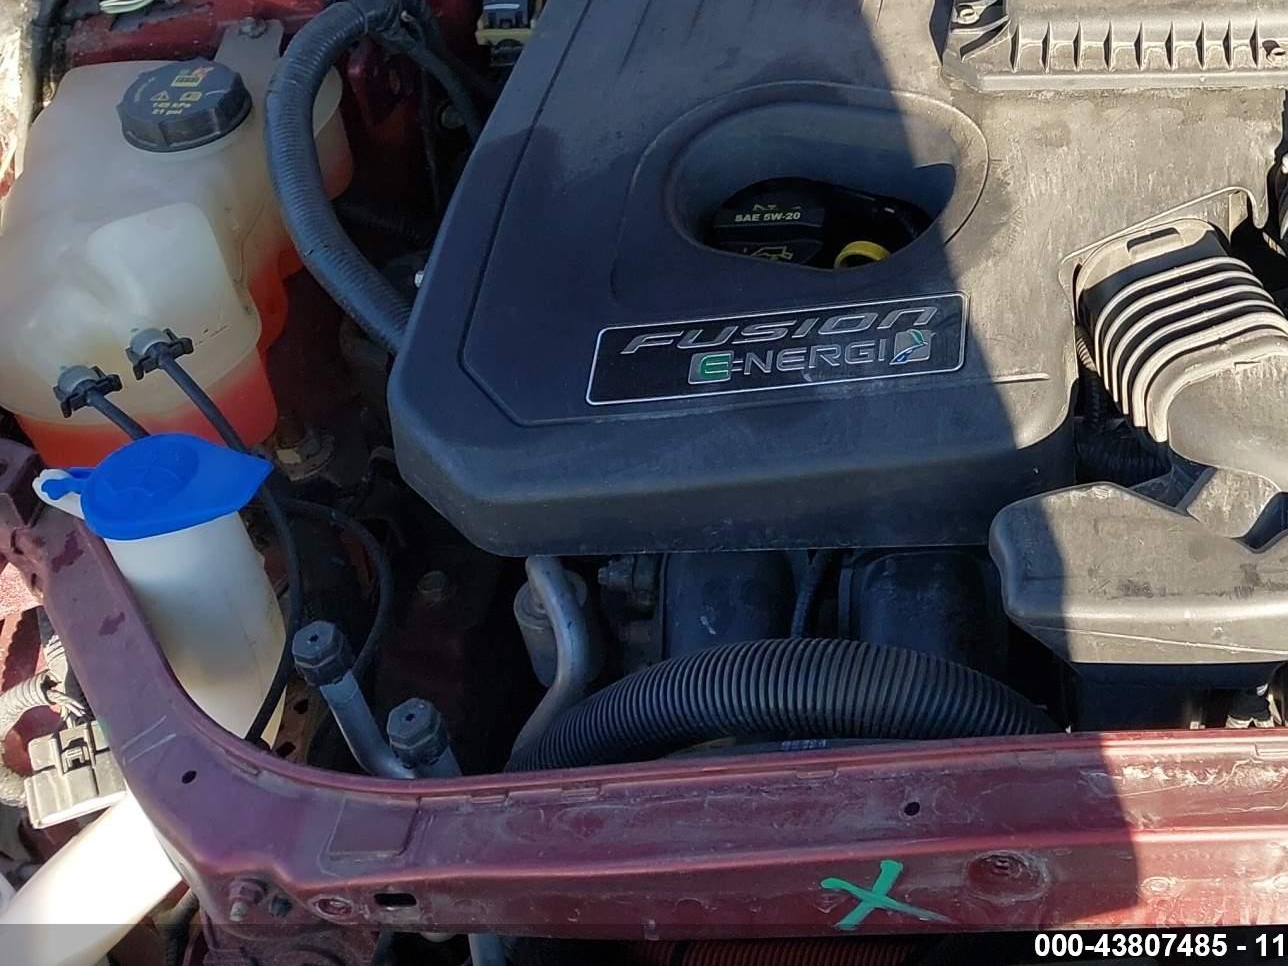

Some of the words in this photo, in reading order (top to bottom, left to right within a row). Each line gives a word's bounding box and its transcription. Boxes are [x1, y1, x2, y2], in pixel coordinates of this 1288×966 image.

[734, 213, 760, 222] SAE
[763, 211, 801, 222] 5W-20
[619, 305, 939, 356] FUSION
